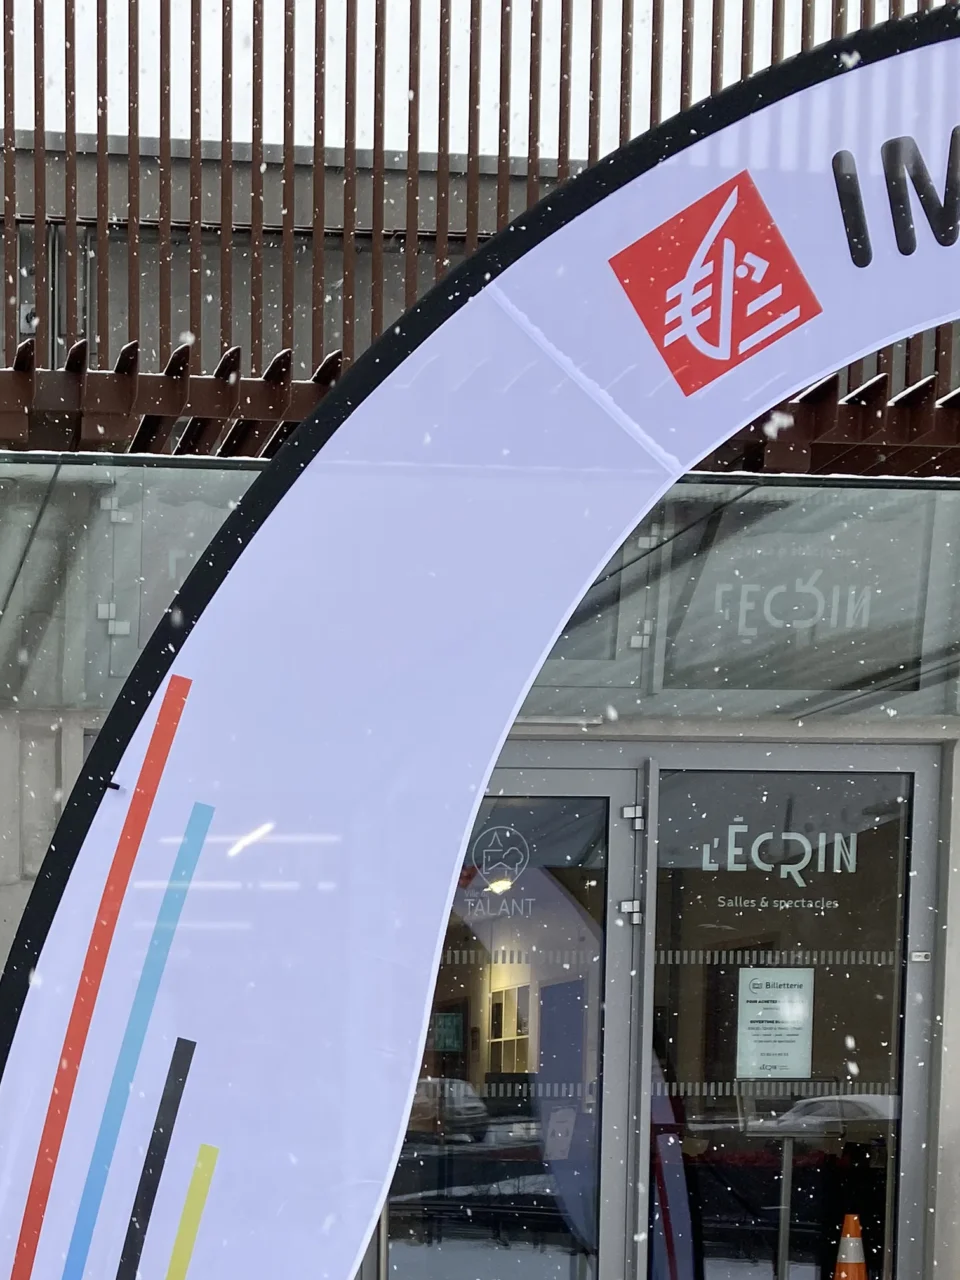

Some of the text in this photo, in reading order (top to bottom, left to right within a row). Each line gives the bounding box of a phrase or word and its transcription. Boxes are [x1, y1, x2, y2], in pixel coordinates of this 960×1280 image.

[702, 815, 858, 887] L'ÉCRIN
[464, 898, 536, 916] TALANT
[717, 896, 839, 910] Salles & spectacles
